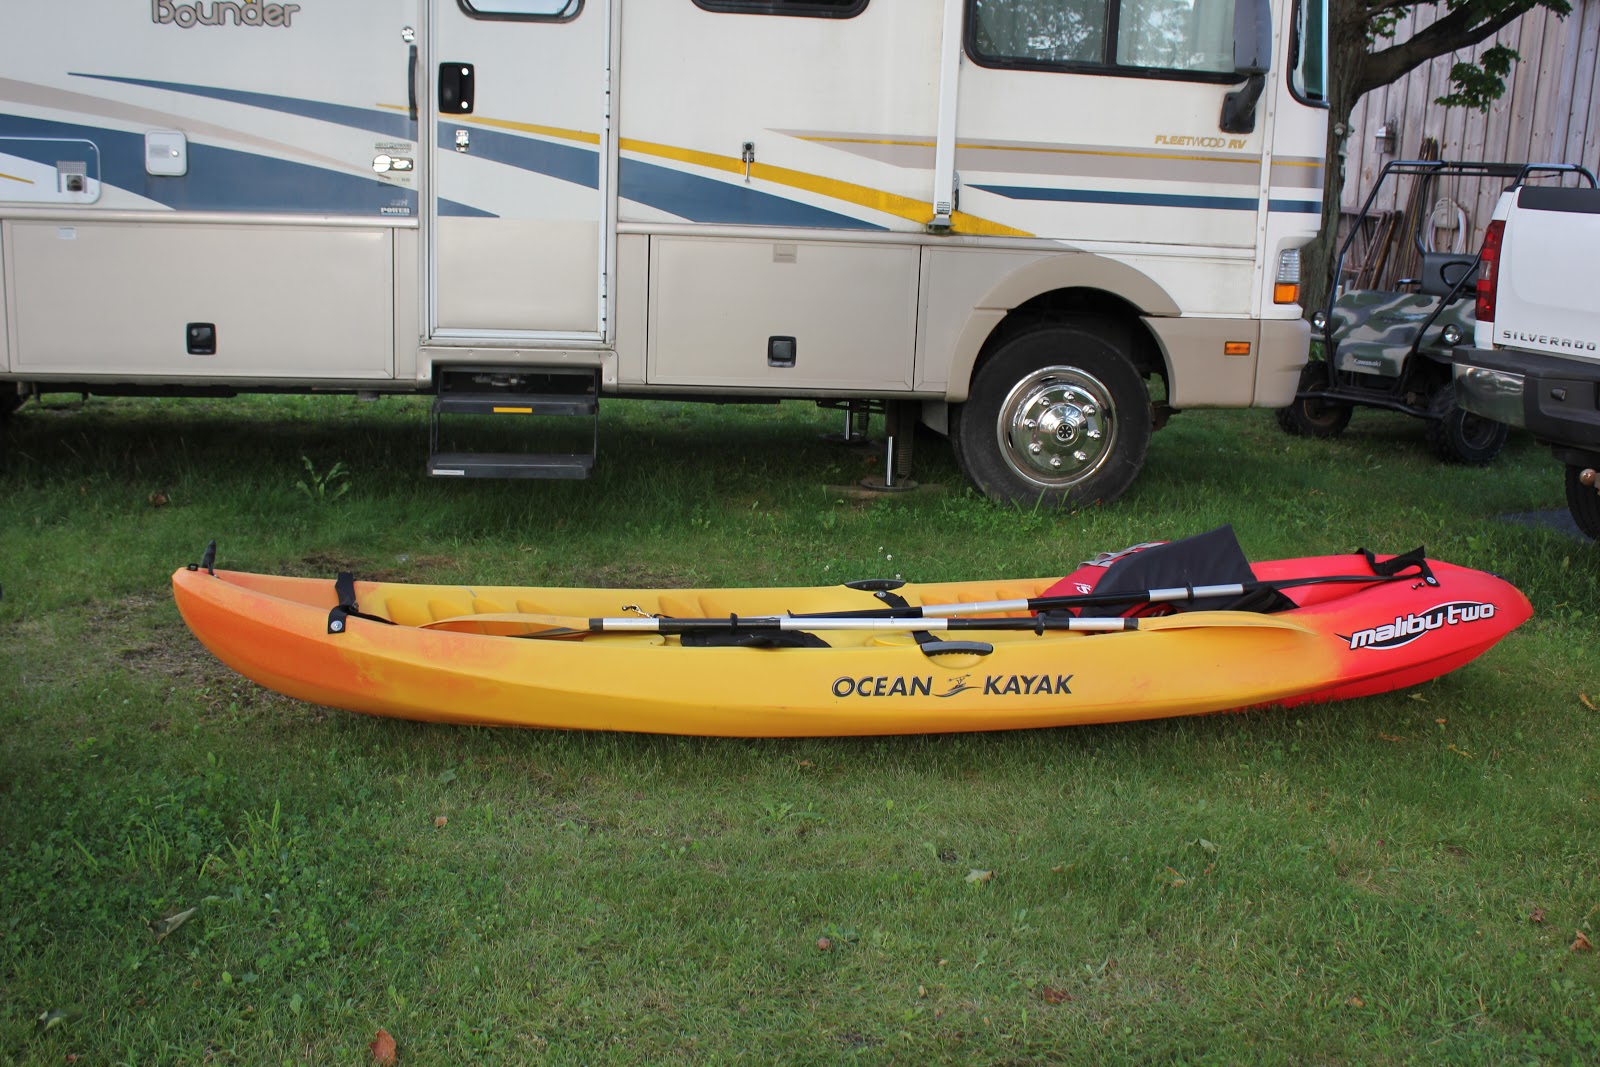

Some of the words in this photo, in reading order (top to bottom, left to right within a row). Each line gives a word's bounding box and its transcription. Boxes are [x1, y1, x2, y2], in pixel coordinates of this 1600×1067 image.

[151, 0, 301, 28] Bounder
[1155, 135, 1226, 148] FLEETWOOD
[1228, 139, 1247, 149] RV
[1503, 330, 1597, 351] SILVERADO
[1353, 358, 1382, 368] Kawasaki
[1349, 613, 1444, 650] malibu
[1446, 603, 1496, 626] two
[831, 675, 933, 697] OCEAN
[983, 674, 1074, 695] KAYAK
